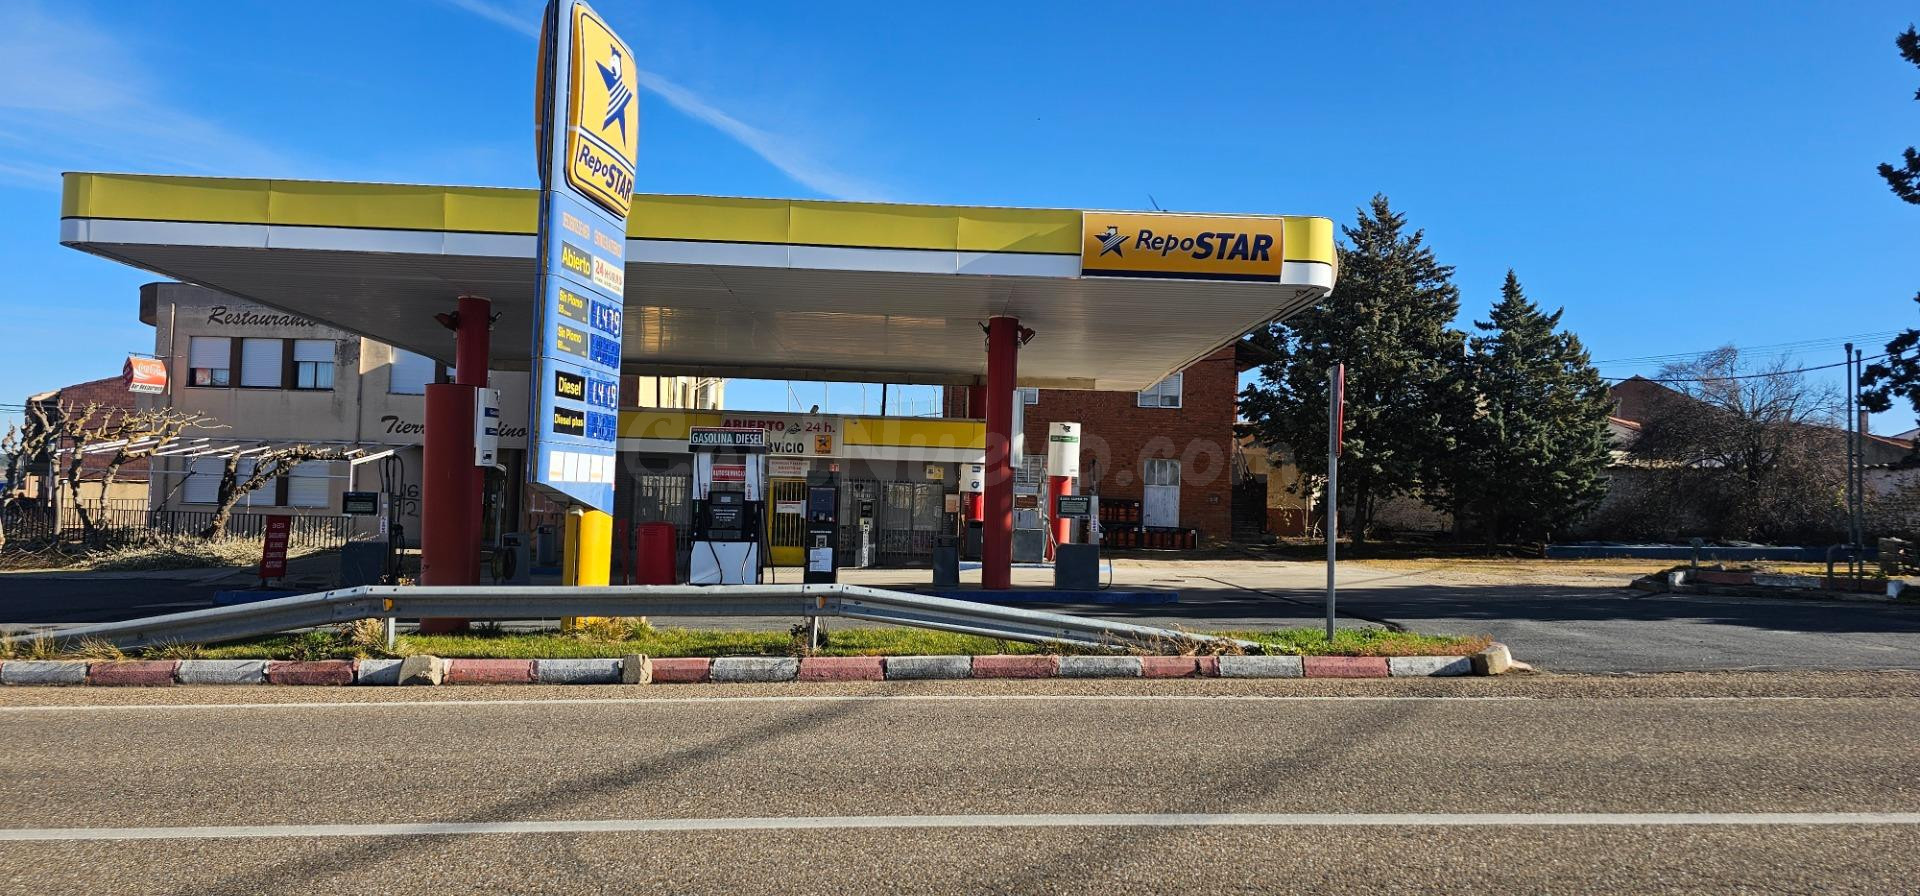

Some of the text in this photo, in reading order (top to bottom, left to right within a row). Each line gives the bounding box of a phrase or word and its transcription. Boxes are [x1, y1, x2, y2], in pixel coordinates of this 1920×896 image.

[579, 144, 633, 204] RepoSTAR
[1135, 229, 1274, 262] RepoSTAR
[562, 246, 591, 276] Abierto
[595, 260, 605, 277] 24
[567, 293, 583, 309] Plomo
[559, 377, 581, 397] Diesel
[554, 413, 583, 429] Diesel plus
[723, 419, 785, 432] ABIERTO
[805, 422, 821, 432] 24
[824, 422, 836, 433] h.
[692, 432, 763, 444] GASOLINA DIESEL
